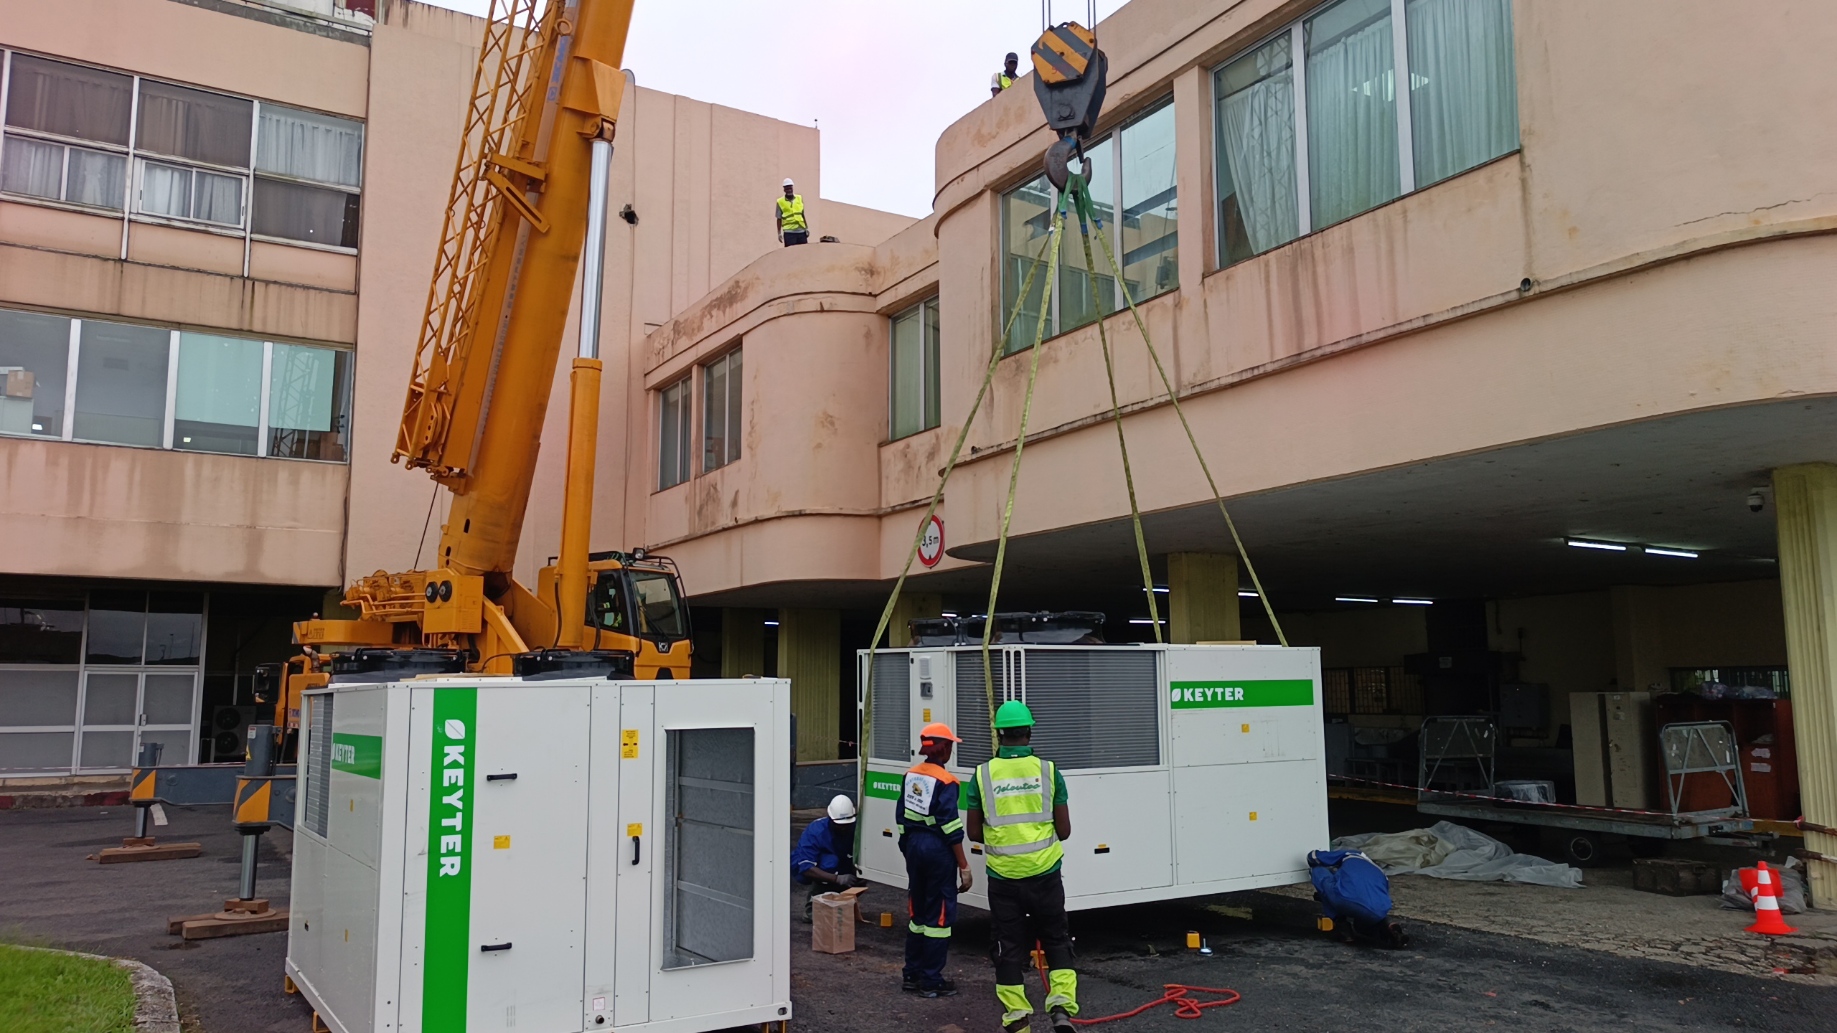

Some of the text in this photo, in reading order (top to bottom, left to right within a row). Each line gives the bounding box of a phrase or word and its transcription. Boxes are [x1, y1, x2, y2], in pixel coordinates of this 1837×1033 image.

[1183, 687, 1244, 702] KEYTER
[334, 743, 355, 765] KEYTER
[878, 781, 901, 792] KEYTER
[439, 745, 465, 878] KEYTER
